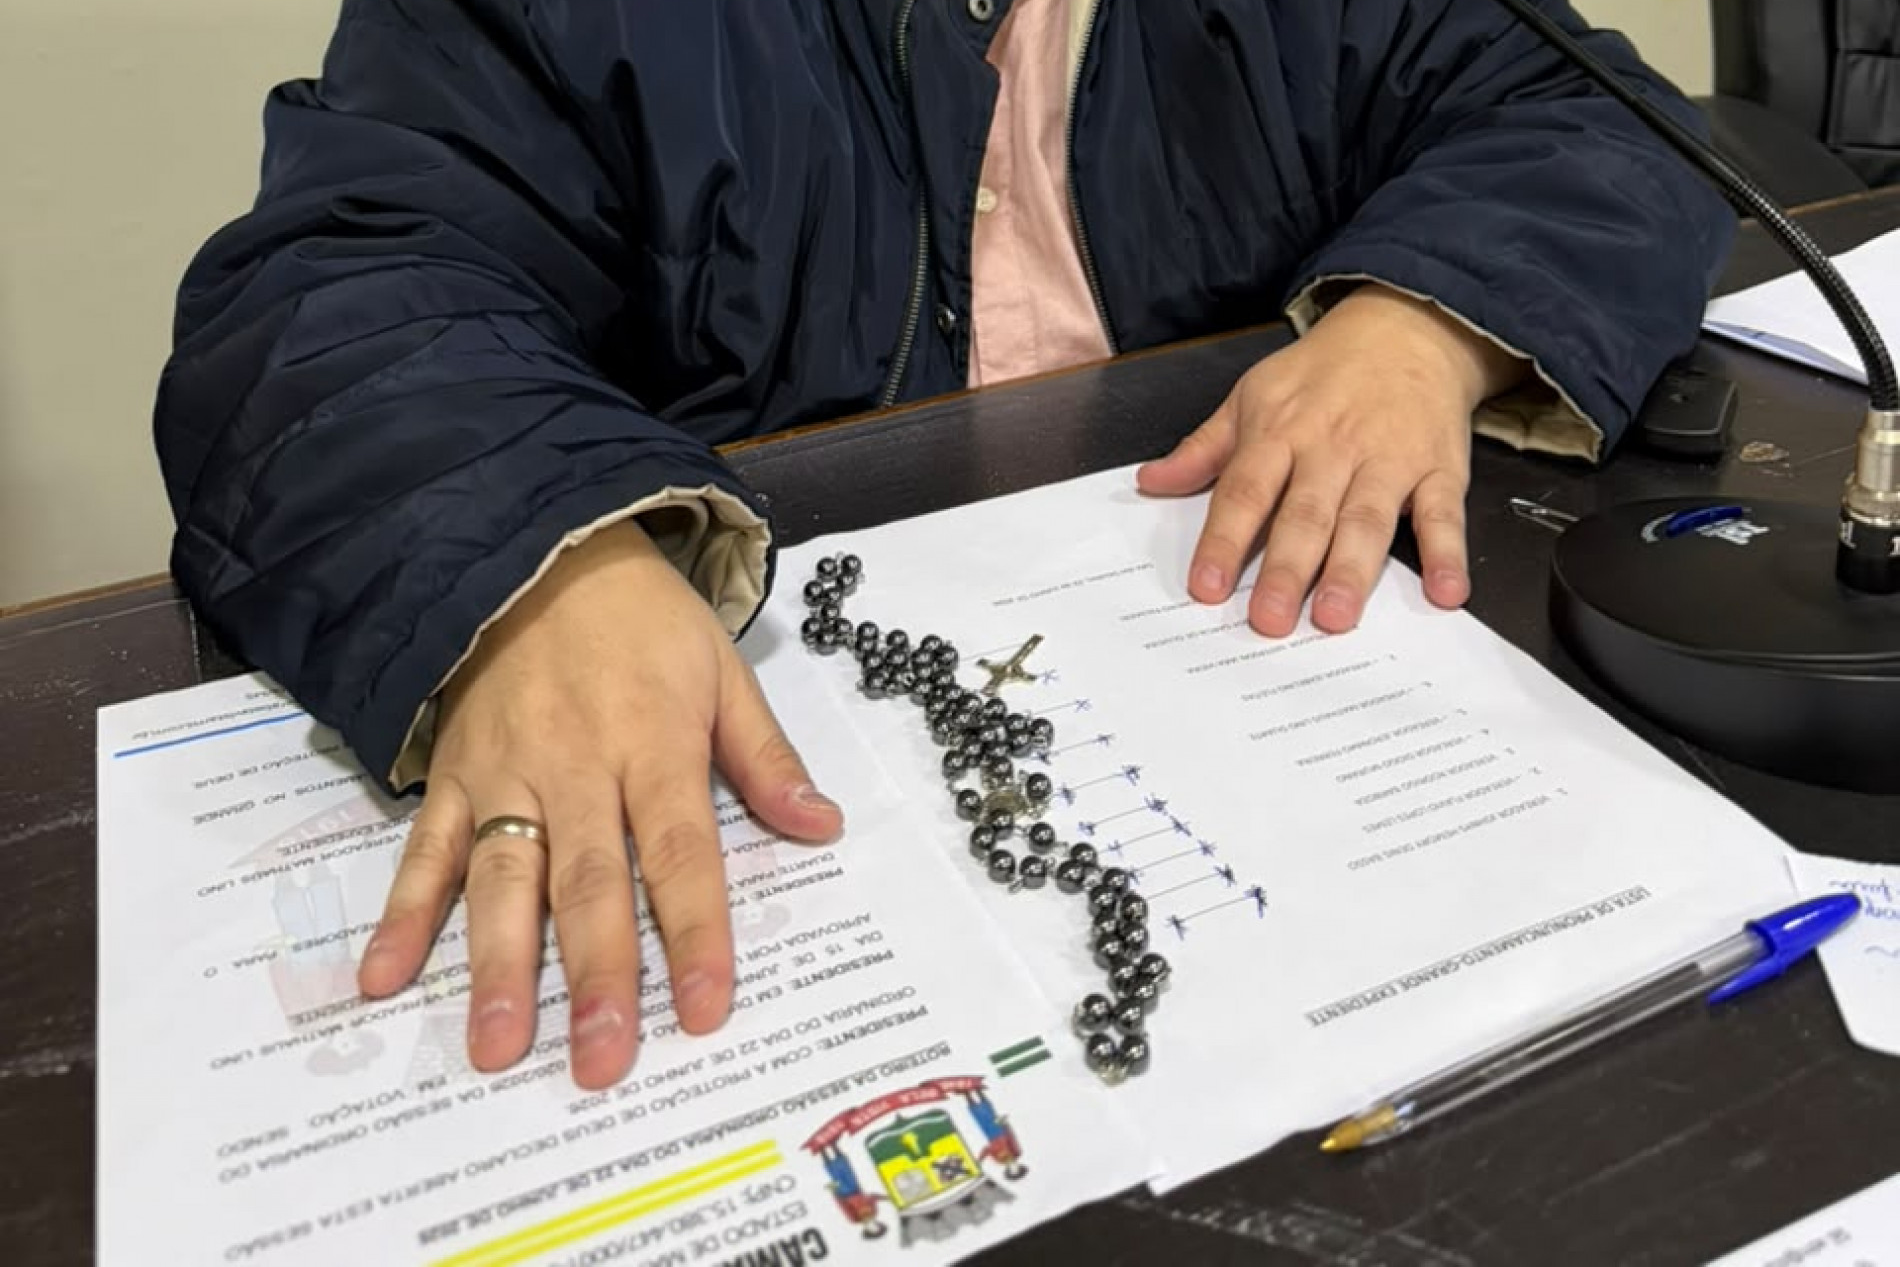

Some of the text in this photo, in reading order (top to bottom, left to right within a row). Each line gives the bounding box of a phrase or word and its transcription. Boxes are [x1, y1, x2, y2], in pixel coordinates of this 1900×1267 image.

[1412, 735, 1466, 758] VEREADOR
[237, 765, 259, 777] DE
[1444, 752, 1500, 776] VEREADOR
[1461, 776, 1516, 800] VEREADOR
[191, 791, 287, 825] NO GRANDE
[1494, 794, 1552, 820] VEREADOR
[319, 831, 404, 862] VEREADOR
[775, 851, 836, 874] DUARTE
[195, 879, 236, 897] LINO
[734, 869, 777, 888] PARA
[1590, 898, 1617, 917] DE
[1609, 884, 1652, 909] LISTA
[744, 912, 873, 960] APROVADA POR
[853, 929, 885, 946] DIA
[230, 948, 279, 969] PARA
[790, 951, 817, 966] DE
[753, 985, 785, 1002] EM
[820, 982, 918, 1028] ORDINÁRIA
[1304, 981, 1400, 1027] EXPEDIENTE
[347, 992, 446, 1029] VEREADOR
[759, 1025, 794, 1048] DIA
[791, 1015, 824, 1036] DO
[708, 1046, 737, 1065] DE
[737, 1038, 761, 1055] 22
[208, 1048, 255, 1070] LINO
[874, 1041, 953, 1079] ROTEIRO
[414, 1074, 450, 1092] EM
[644, 1057, 708, 1089] JUNHO
[846, 1068, 879, 1089] DA
[454, 1086, 487, 1105] DA
[612, 1081, 643, 1100] DE
[779, 1078, 852, 1114] SESSÃO
[368, 1094, 455, 1133] SESSÃO
[219, 1002, 929, 1264] PRESIDENTE: COM A PROTEÇÃO DE DEUS DECLARO ABERTA ESTA SESSÃO
[680, 1103, 782, 1149] ORDINÁRIA
[212, 1124, 292, 1160] SENDO
[650, 1139, 683, 1161] DO
[214, 1161, 255, 1184] DO
[590, 1162, 618, 1182] 22
[615, 1150, 653, 1173] DIA
[562, 1171, 593, 1191] DE
[491, 1182, 562, 1217] JUNHO
[461, 1207, 495, 1228] DE
[724, 1199, 809, 1245] ESTADO
[686, 1232, 721, 1259] DE
